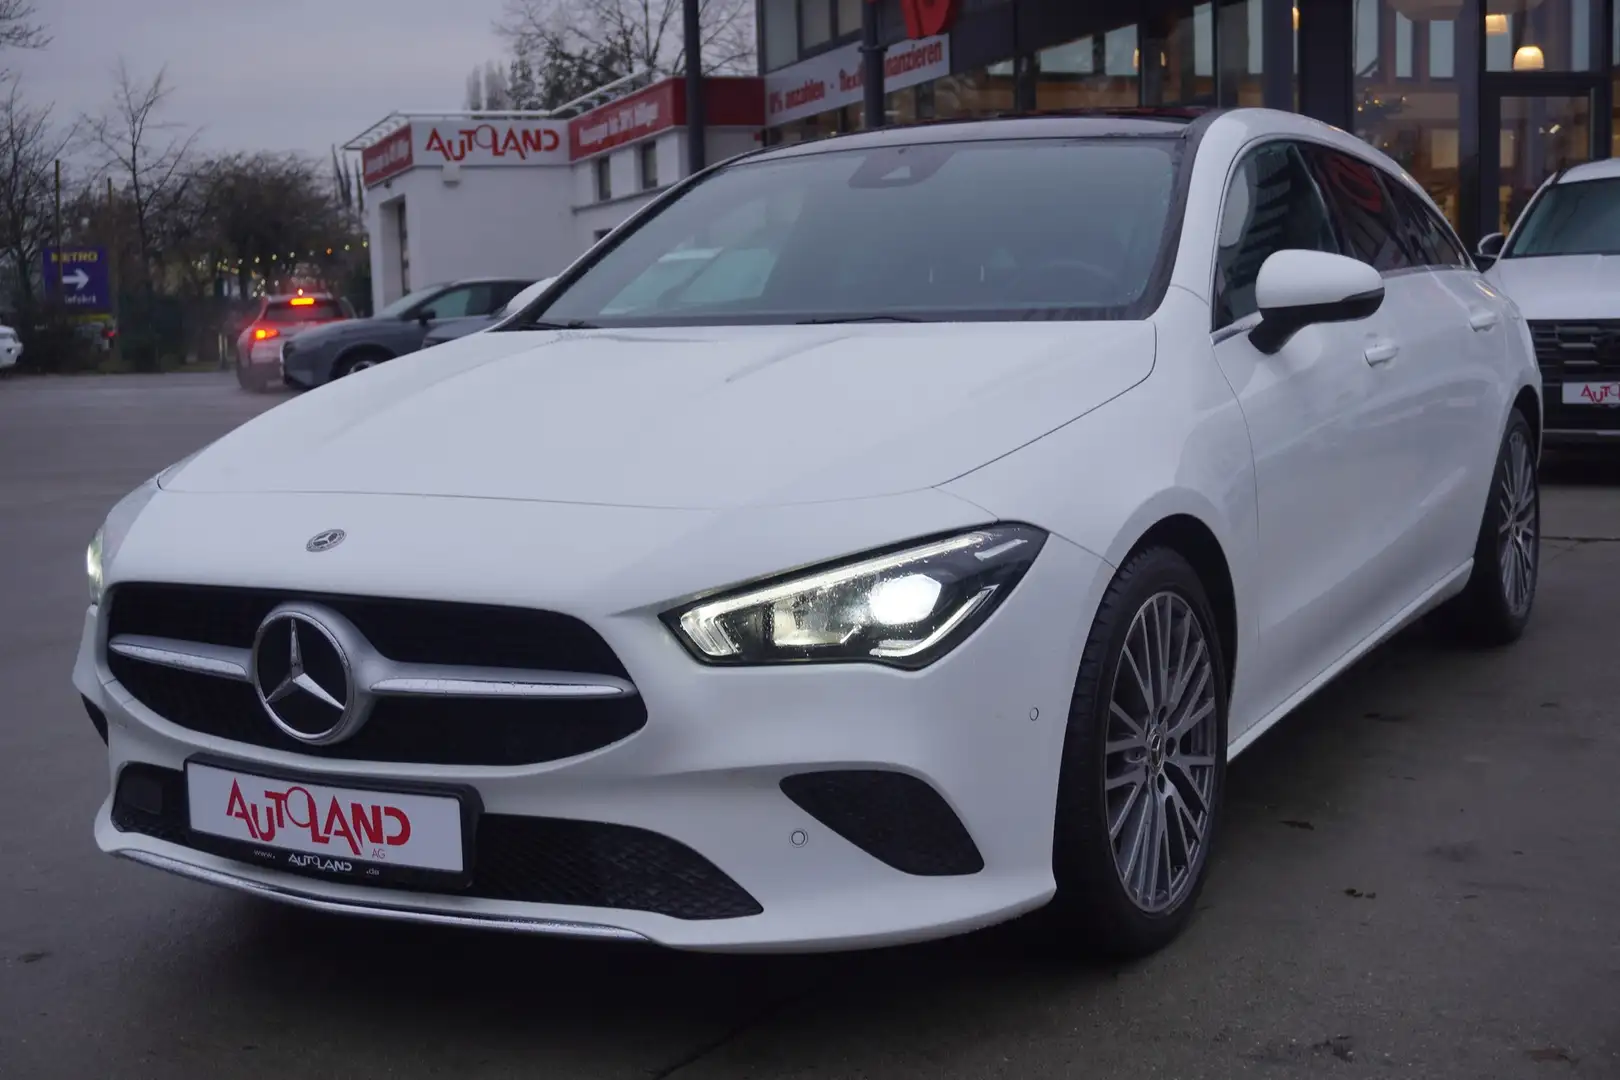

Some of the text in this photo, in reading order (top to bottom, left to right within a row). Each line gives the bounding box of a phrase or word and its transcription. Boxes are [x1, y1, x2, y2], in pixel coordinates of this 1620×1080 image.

[424, 123, 560, 162] AUTOLAND
[226, 777, 412, 857] AUTOLAND
[288, 852, 353, 872] AUTOLAND
[372, 847, 386, 860] AG
